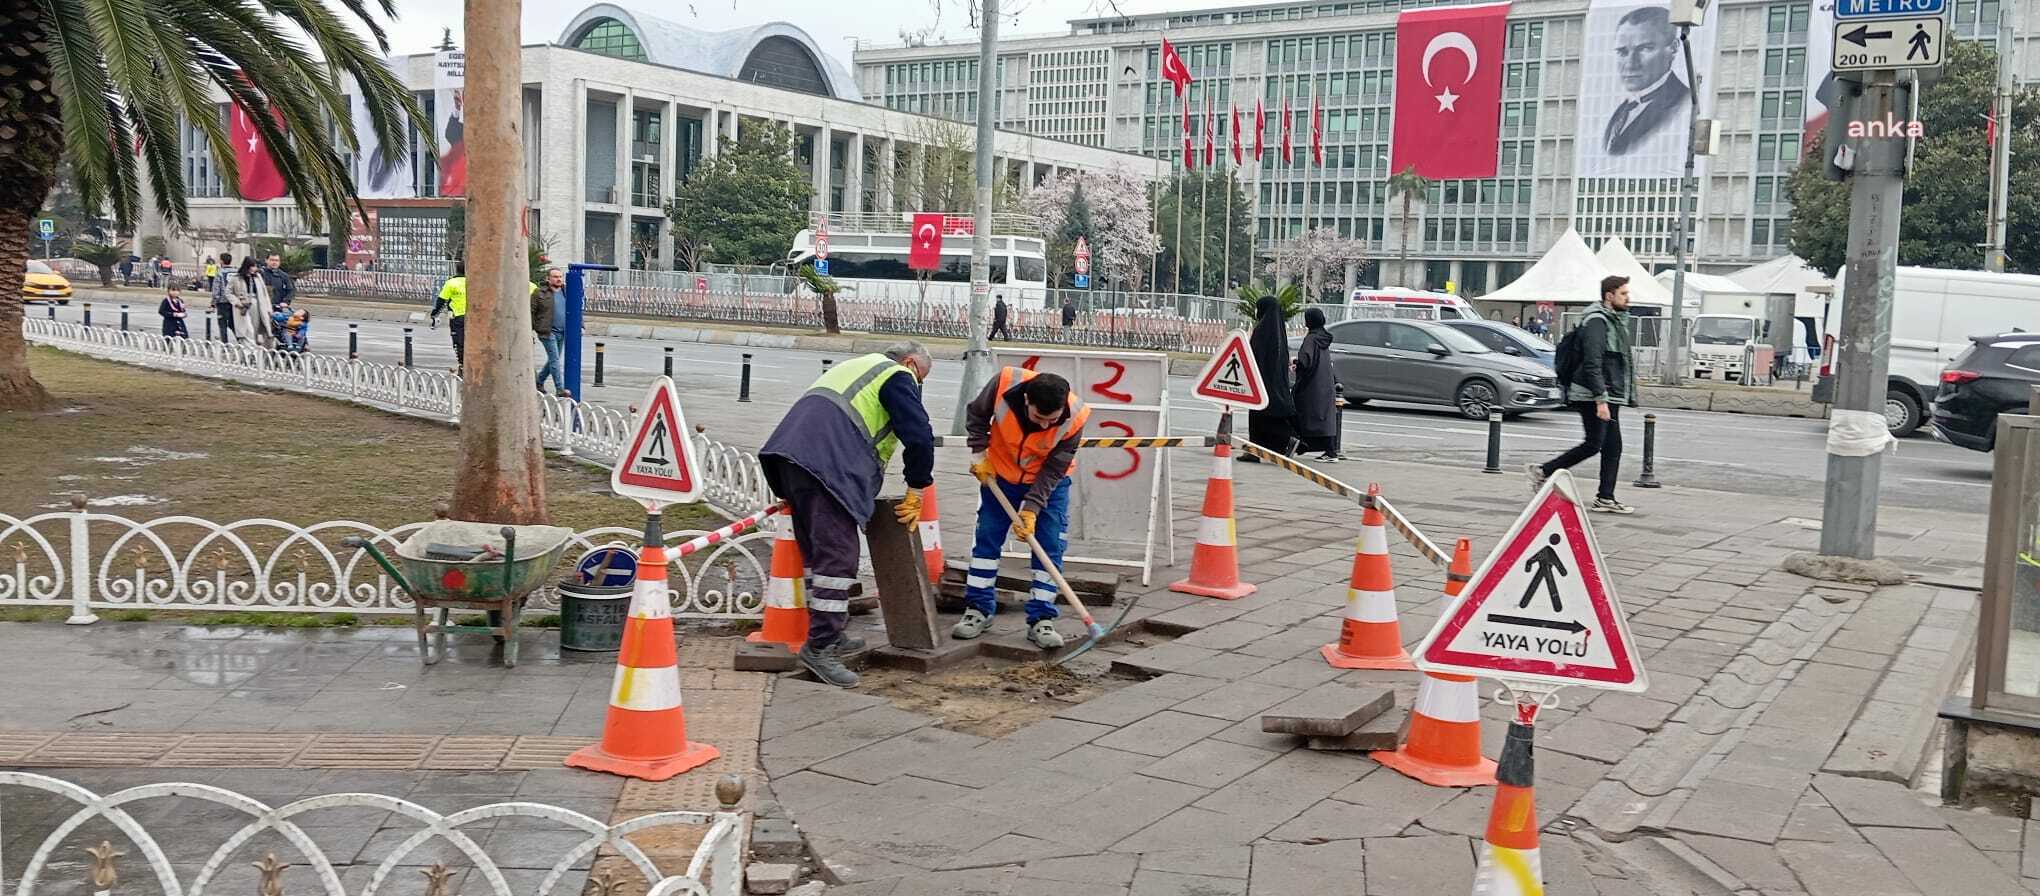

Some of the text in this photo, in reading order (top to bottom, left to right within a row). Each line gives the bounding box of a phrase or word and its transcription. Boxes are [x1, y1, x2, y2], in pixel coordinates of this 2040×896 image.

[1849, 0, 1931, 13] METRO
[1839, 54, 1887, 66] 200 m
[1091, 360, 1133, 404] 2
[1095, 420, 1141, 480] 3
[636, 464, 673, 477] YAYA YOLU
[1483, 631, 1588, 658] YAYA YOLU
